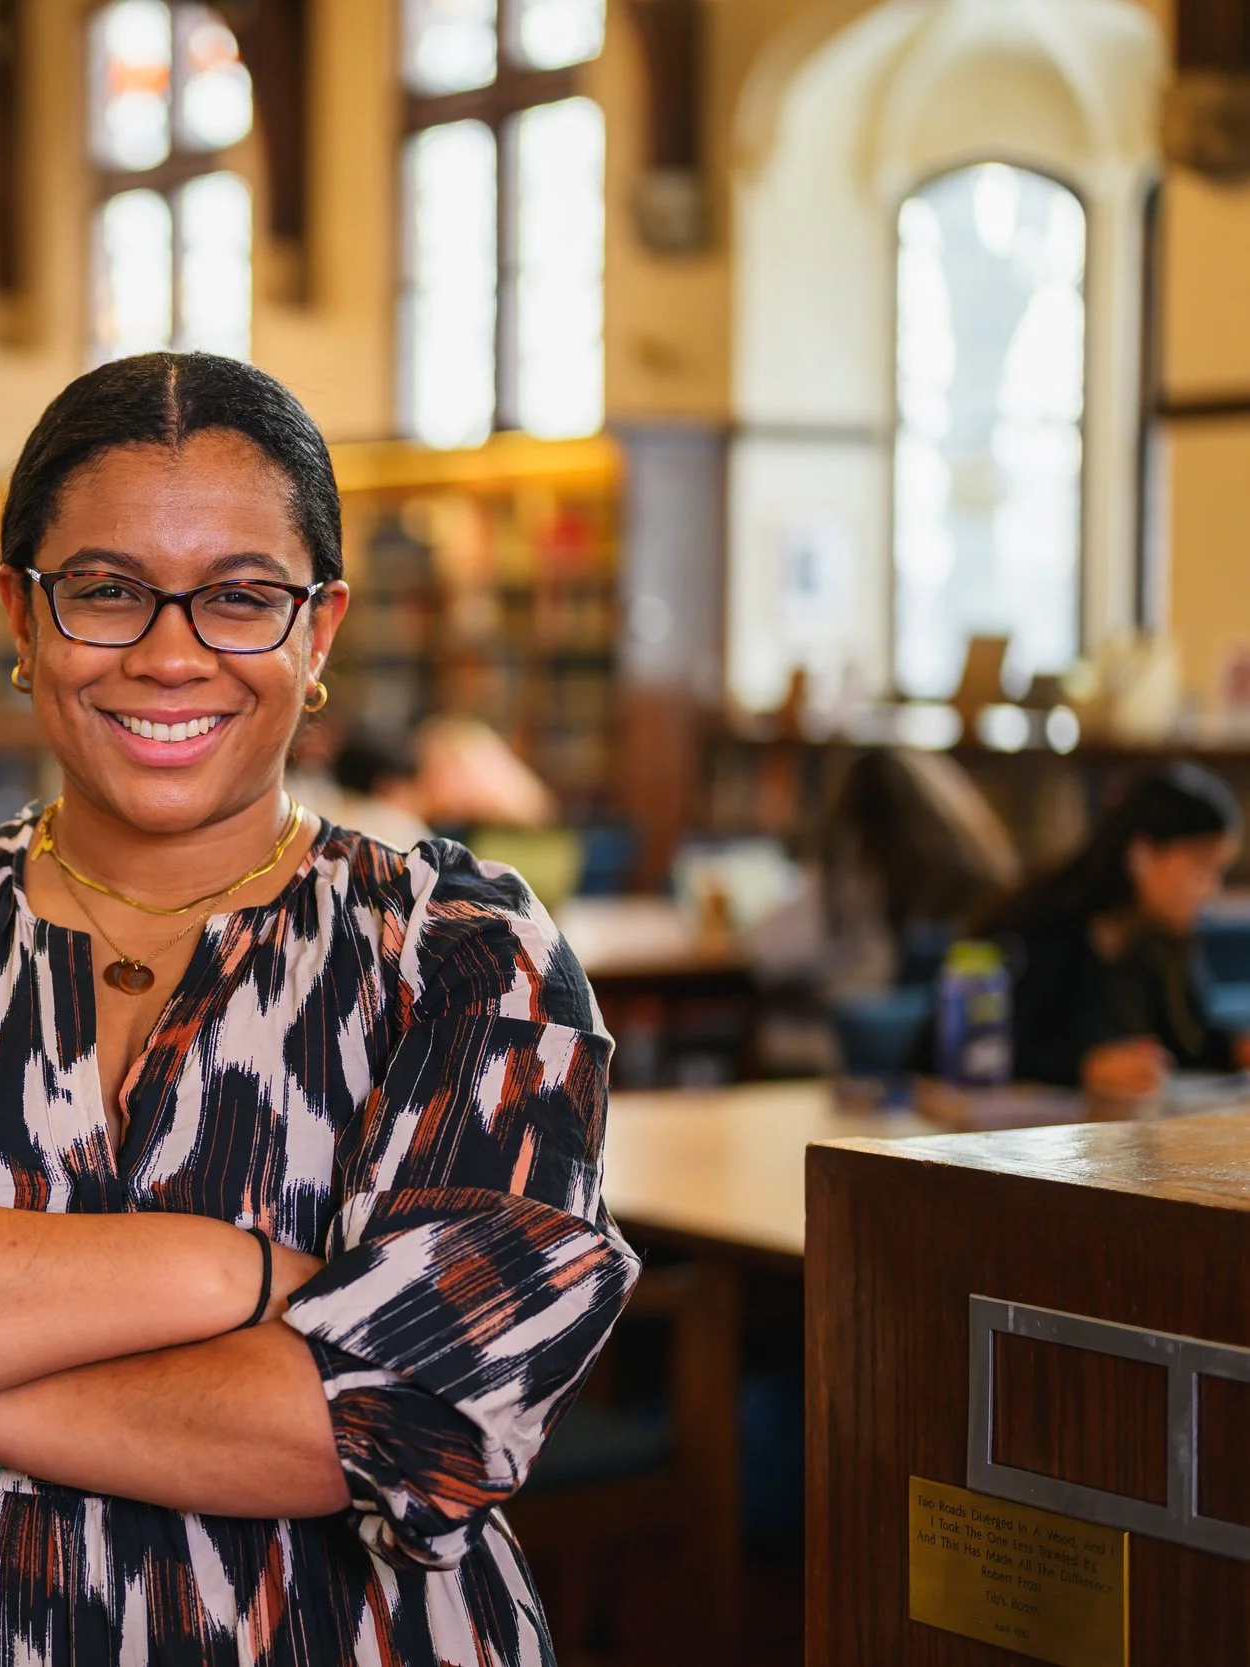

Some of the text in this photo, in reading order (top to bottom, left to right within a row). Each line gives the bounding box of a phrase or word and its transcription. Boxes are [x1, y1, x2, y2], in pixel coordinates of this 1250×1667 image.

[918, 1495, 935, 1509] Two
[939, 1500, 966, 1518] Roads
[972, 1509, 1013, 1530] Diverged
[1019, 1521, 1027, 1535] In
[1033, 1527, 1041, 1536] A
[1083, 1538, 1105, 1556] And
[939, 1518, 960, 1533] Took
[966, 1526, 982, 1540] The
[988, 1532, 1008, 1547] One
[1014, 1539, 1033, 1553] Less
[1039, 1545, 1077, 1566] Traveled
[917, 1531, 935, 1545] And
[941, 1536, 959, 1551] This
[965, 1543, 981, 1557] Has
[986, 1550, 1012, 1566] Made
[1019, 1559, 1031, 1572] All
[1037, 1563, 1055, 1578] The
[981, 1566, 1042, 1593] Robert Frost
